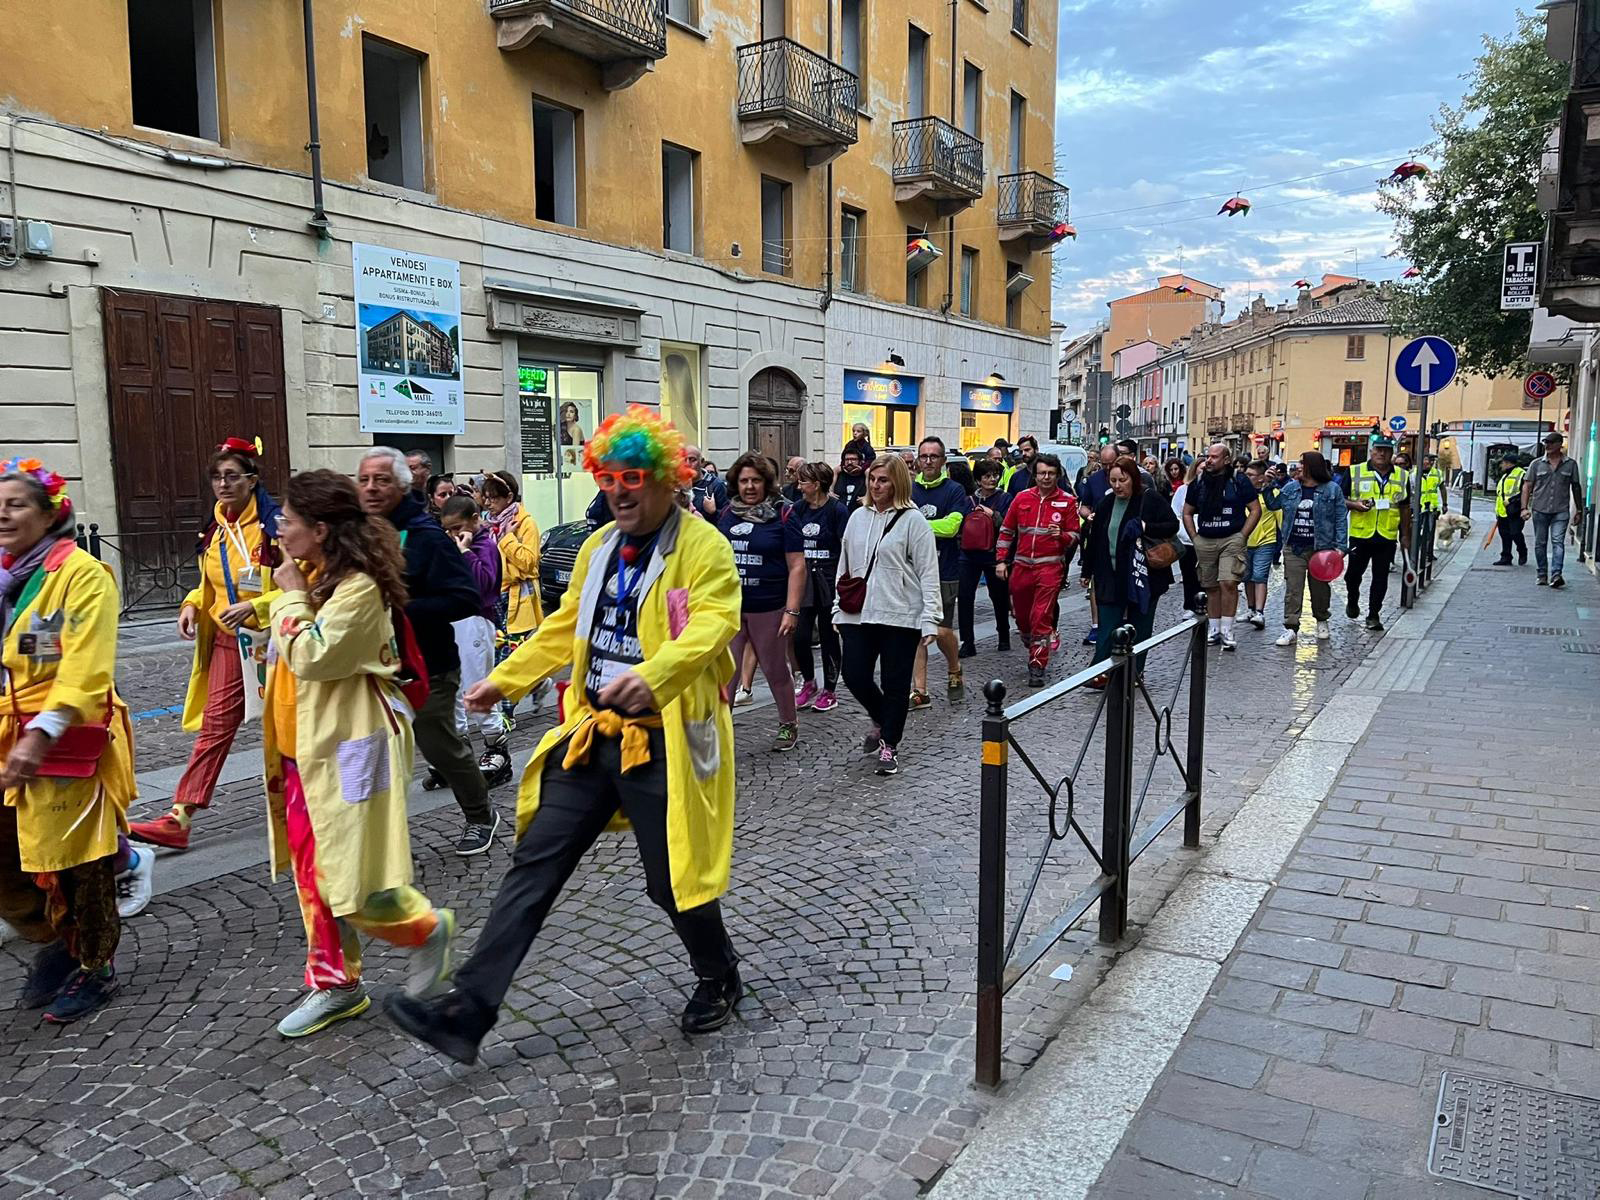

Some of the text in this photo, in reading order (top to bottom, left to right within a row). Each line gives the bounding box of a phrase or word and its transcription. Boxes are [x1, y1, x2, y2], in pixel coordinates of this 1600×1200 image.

[390, 256, 427, 271] VENDESI
[362, 265, 453, 289] APPARTAMENTI E BOX
[378, 292, 396, 301] BONUS
[386, 409, 443, 417] TELEFONO 0383-366015
[731, 540, 749, 551] TOMMY
